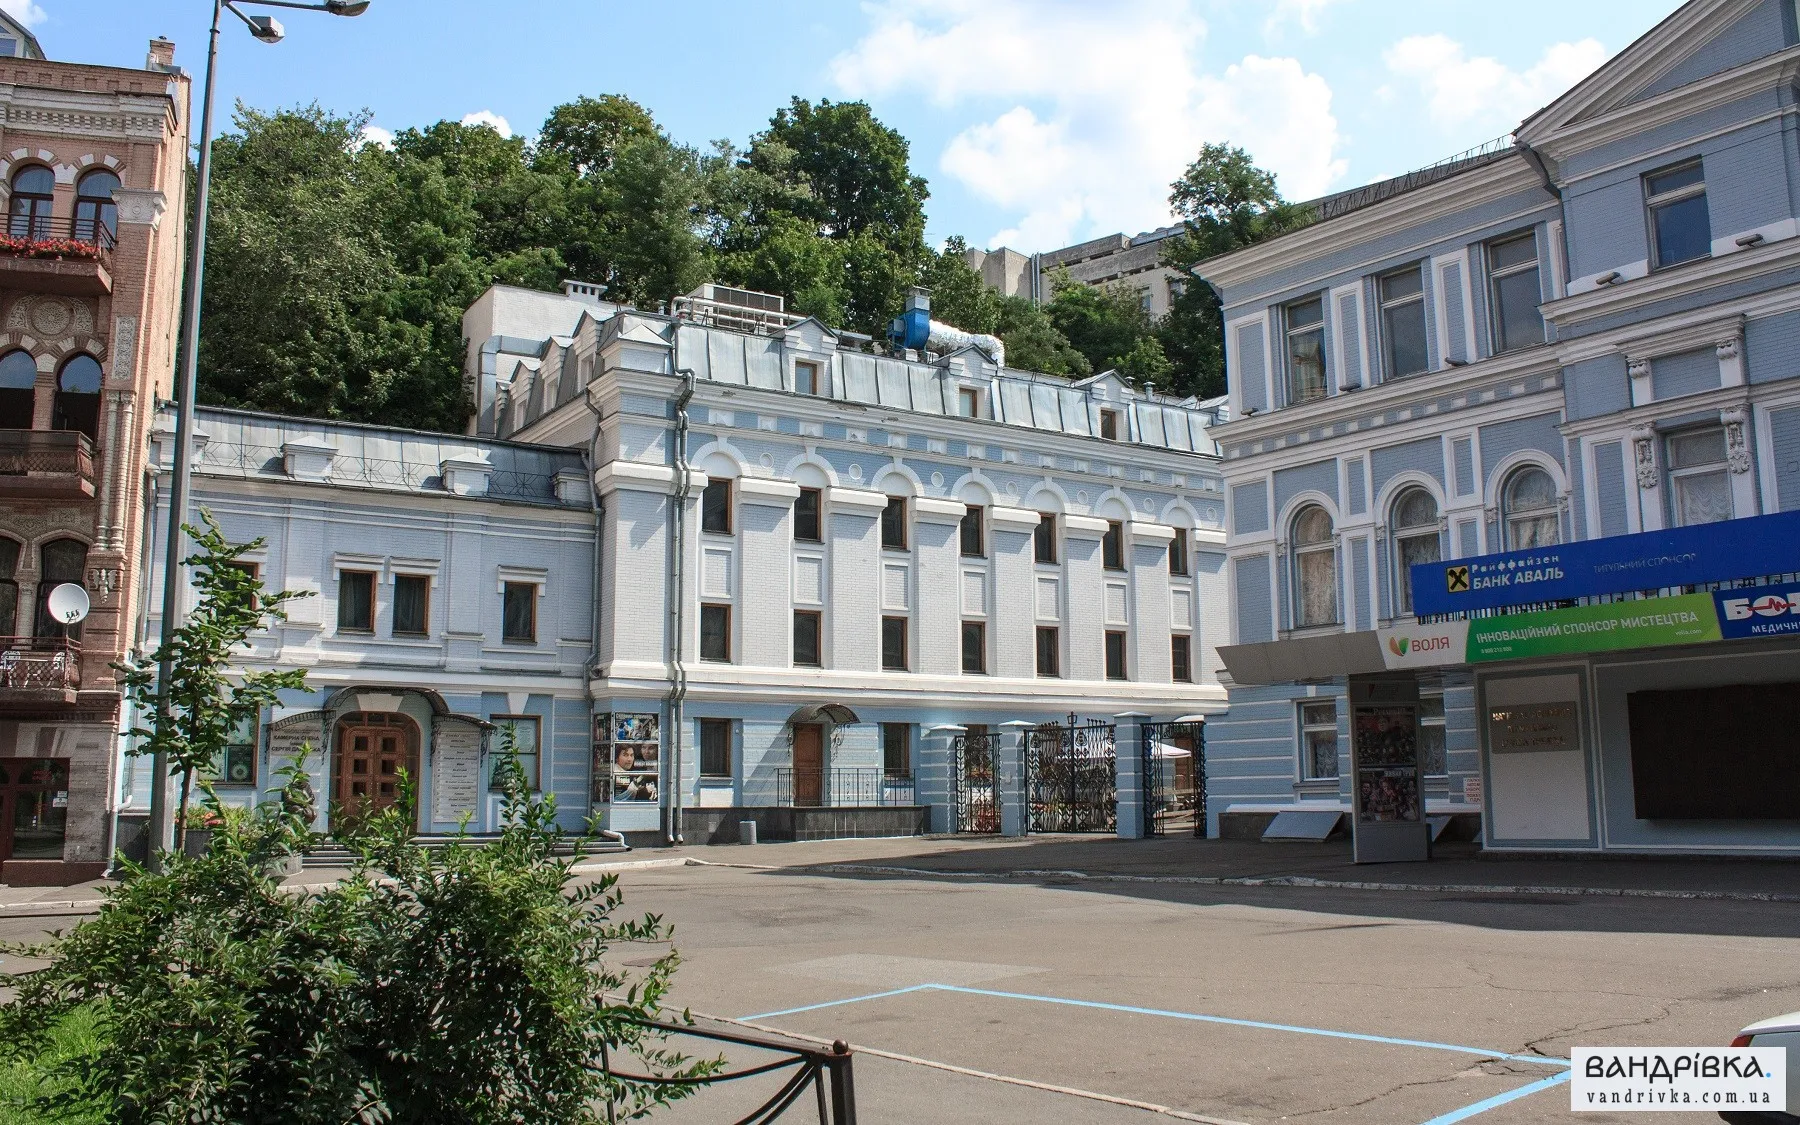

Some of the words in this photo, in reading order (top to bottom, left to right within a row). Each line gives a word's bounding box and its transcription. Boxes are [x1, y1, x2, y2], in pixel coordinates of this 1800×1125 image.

[1471, 555, 1560, 574] Райффайзен
[1593, 559, 1645, 574] ТИТУЛЬНИЙ
[1647, 553, 1696, 567] СПОНСОР
[1473, 573, 1510, 590] БАНК
[1514, 567, 1564, 585] АВАЛЬ
[1476, 622, 1561, 643] ІННОВАЦІЙНИЙ
[1563, 619, 1618, 635] СПОНСОР
[1621, 611, 1699, 629] МИСТЕЦТВА
[1751, 622, 1800, 633] МЕДИЧН
[1411, 636, 1450, 653] ВОЛЯ
